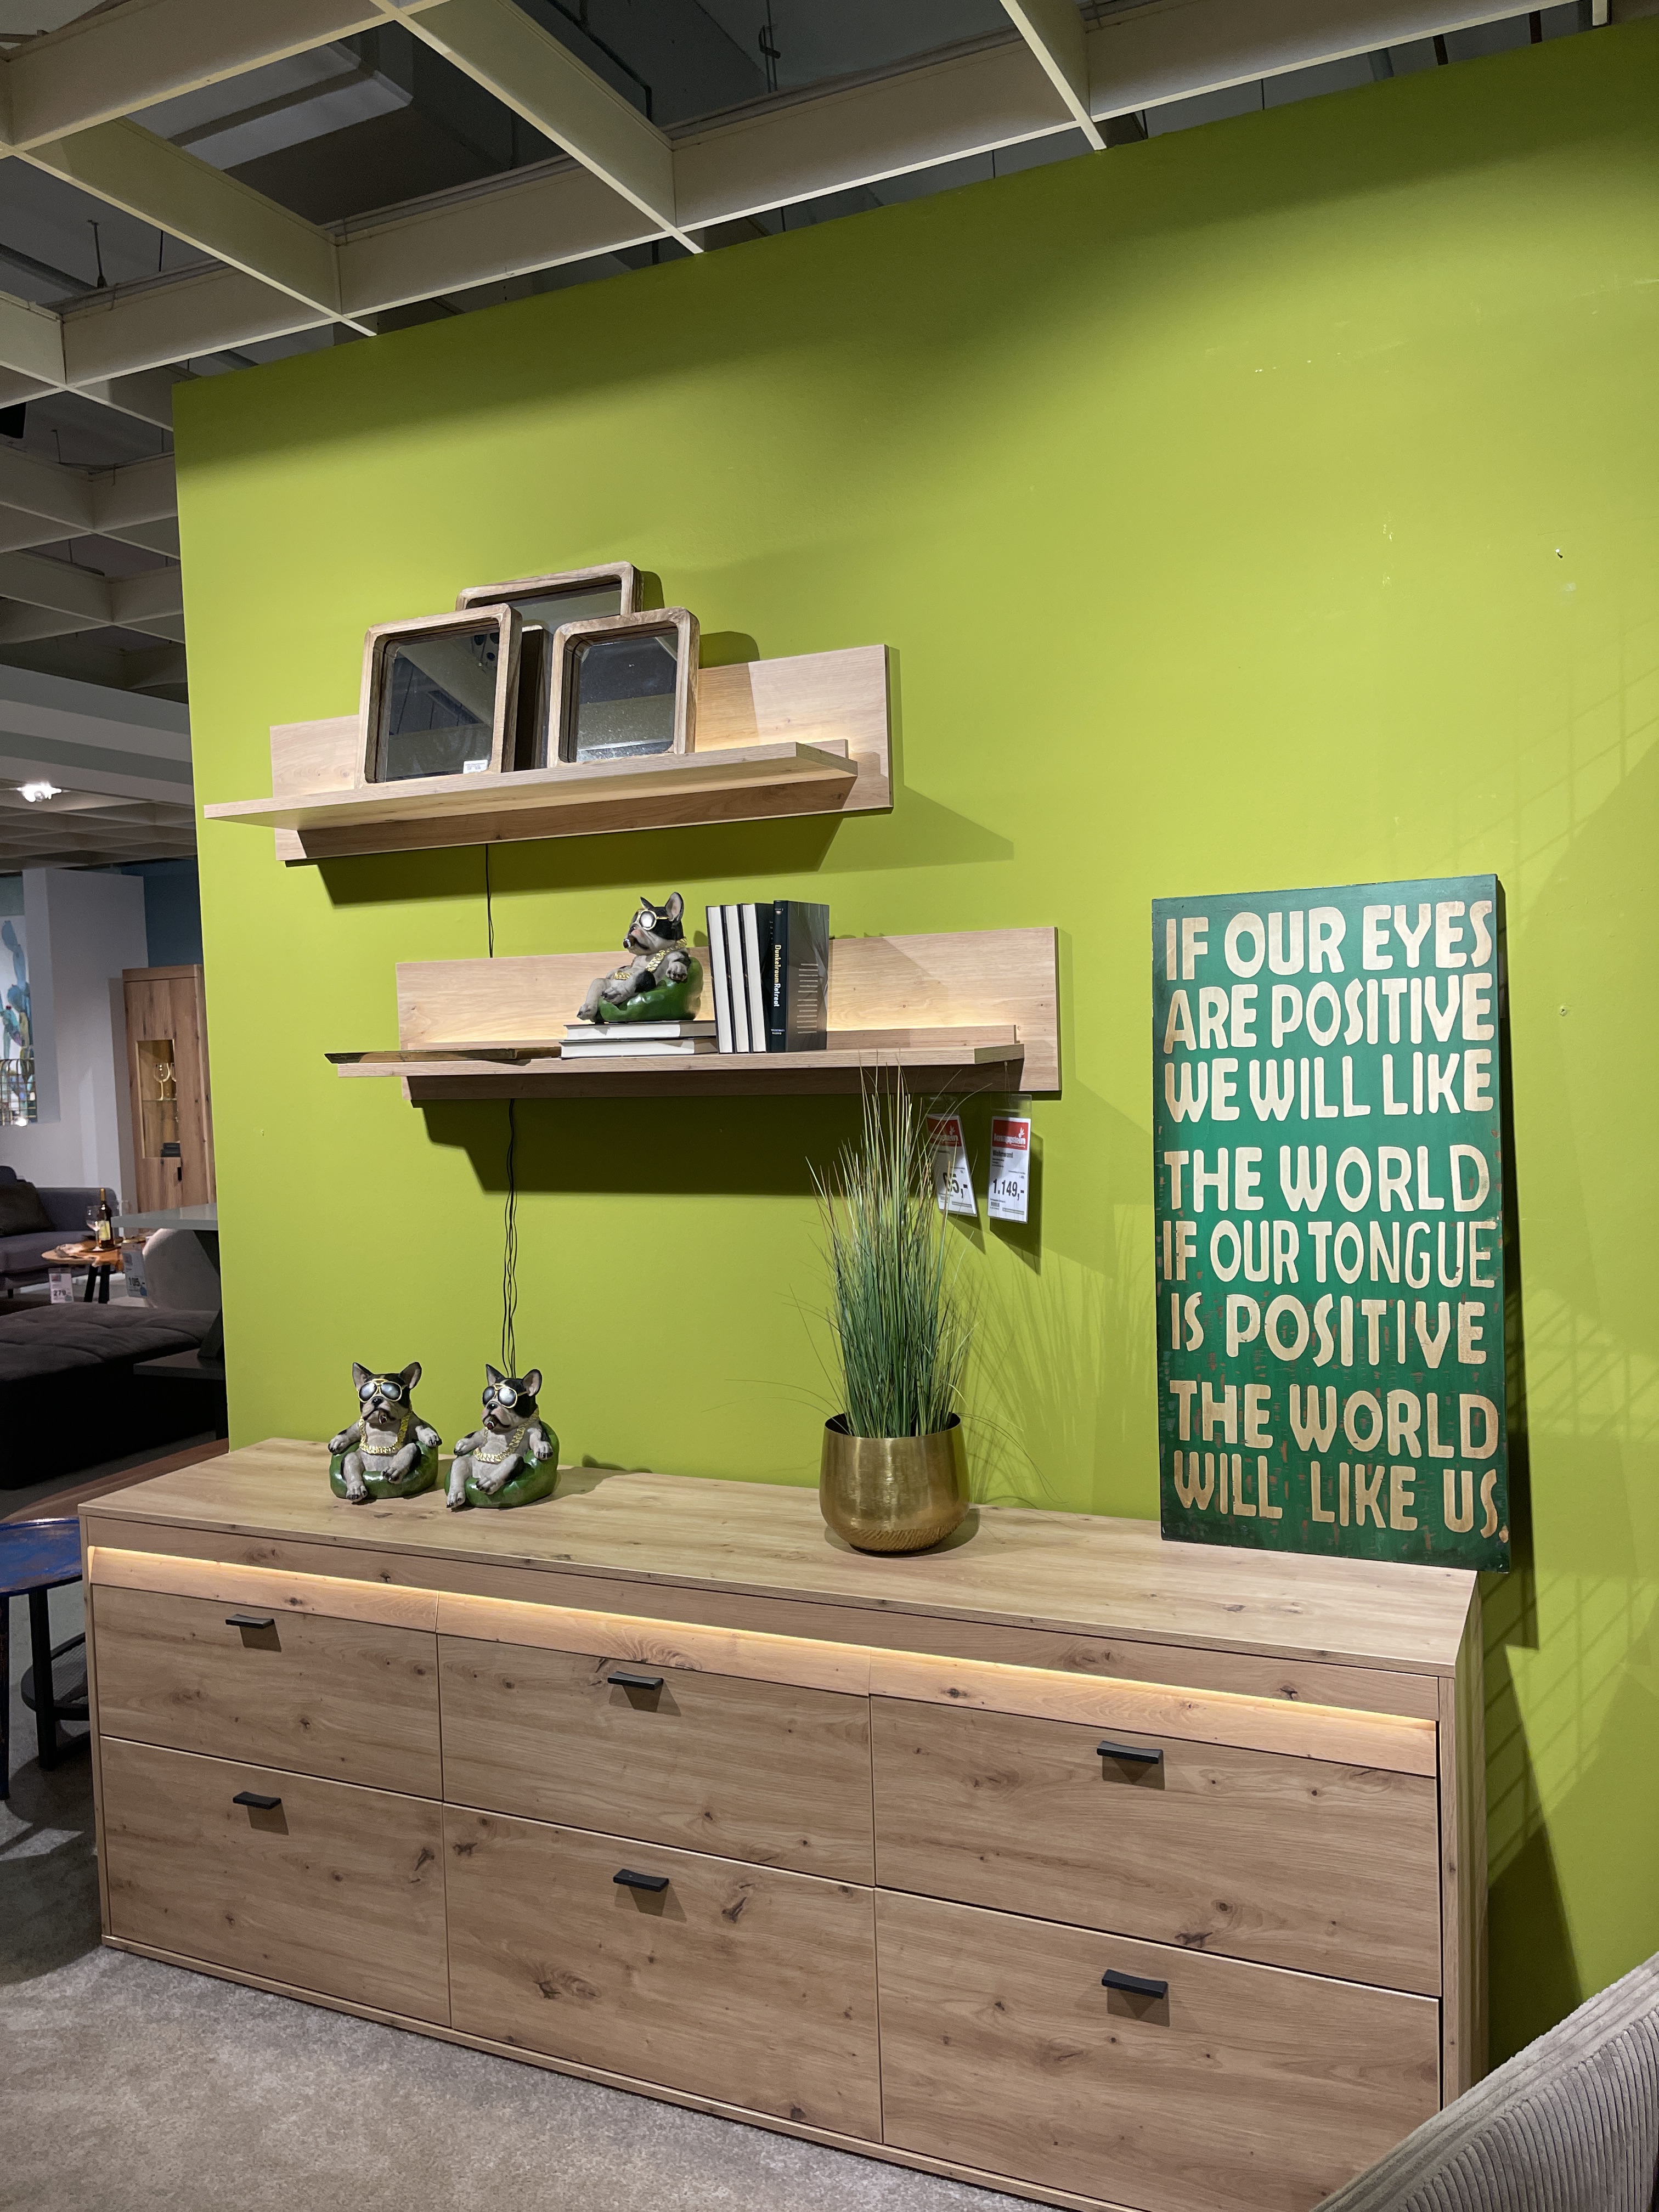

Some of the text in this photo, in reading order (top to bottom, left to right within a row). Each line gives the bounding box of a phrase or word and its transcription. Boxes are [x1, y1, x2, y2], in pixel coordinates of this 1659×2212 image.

[1166, 901, 1492, 980] IF OUR EYES
[1164, 972, 1494, 1054] ARE POSITIVE
[1165, 1048, 1493, 1122] WE WILL LIKE
[993, 1178, 1025, 1201] 1.149,-
[1164, 1144, 1490, 1212] THE WORLD
[1163, 1220, 1496, 1288] IF OUR TONGUE
[1171, 1291, 1487, 1369] IS POSITIVE
[1170, 1380, 1499, 1459] THE WORLD
[1173, 1450, 1283, 1519] WILL
[1311, 1460, 1418, 1531] LIKE
